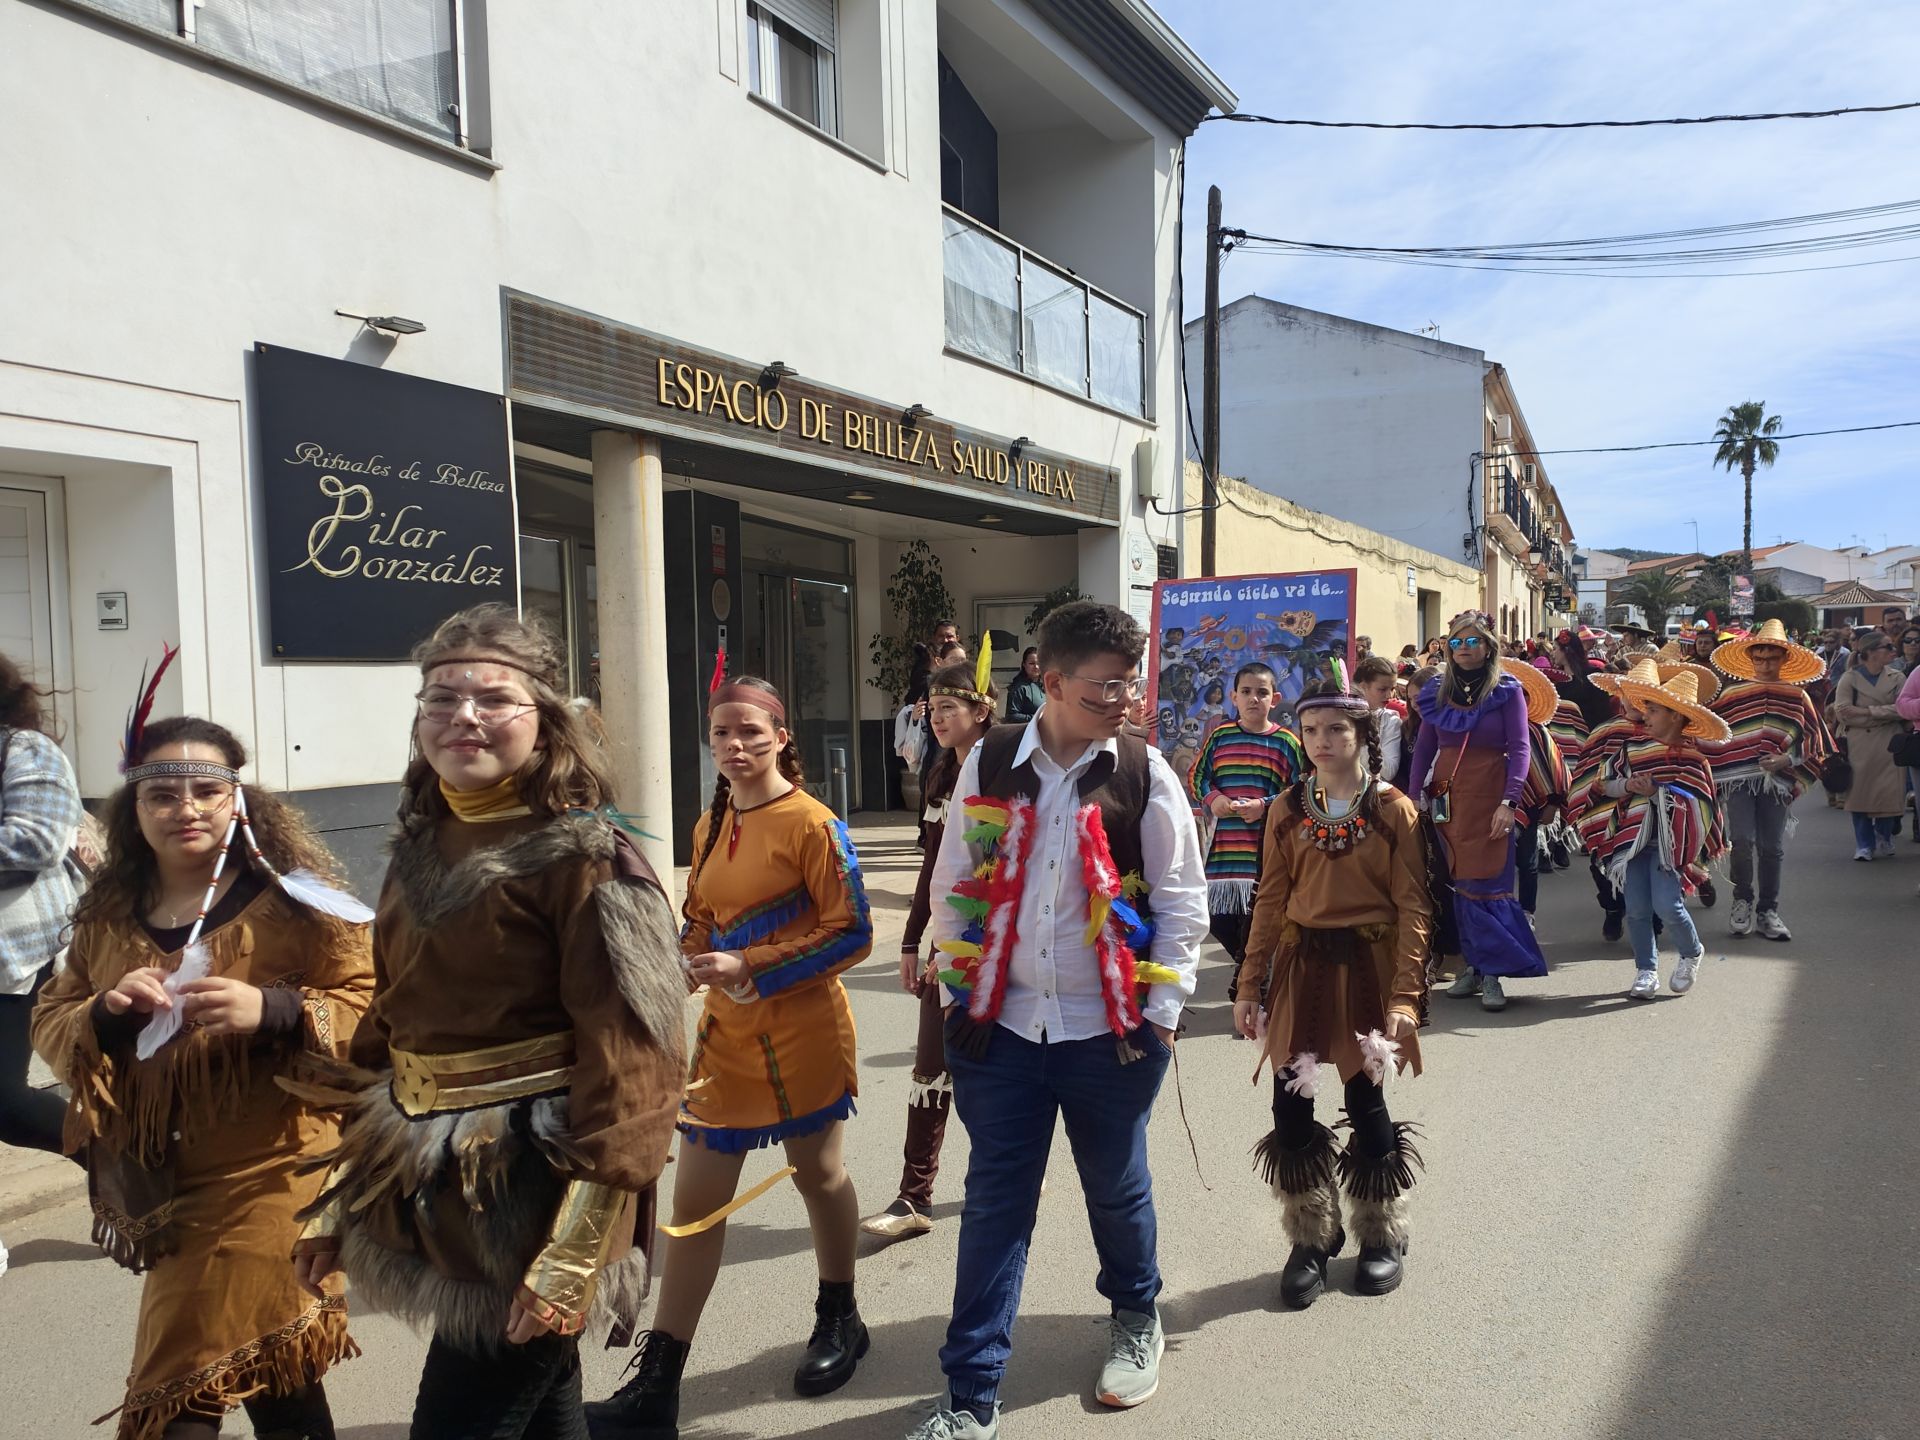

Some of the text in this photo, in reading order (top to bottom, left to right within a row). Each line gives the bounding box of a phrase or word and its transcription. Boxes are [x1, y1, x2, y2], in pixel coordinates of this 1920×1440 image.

[657, 358, 788, 431] ESPACIO
[800, 397, 834, 444] DE
[951, 440, 1010, 485] SALUD
[1013, 457, 1026, 488] Y
[1027, 460, 1077, 501] RELAX
[284, 442, 505, 493] Rituales de Belleza
[302, 475, 447, 555] Pilar
[1161, 585, 1233, 607] Segundo
[1284, 582, 1306, 598] va
